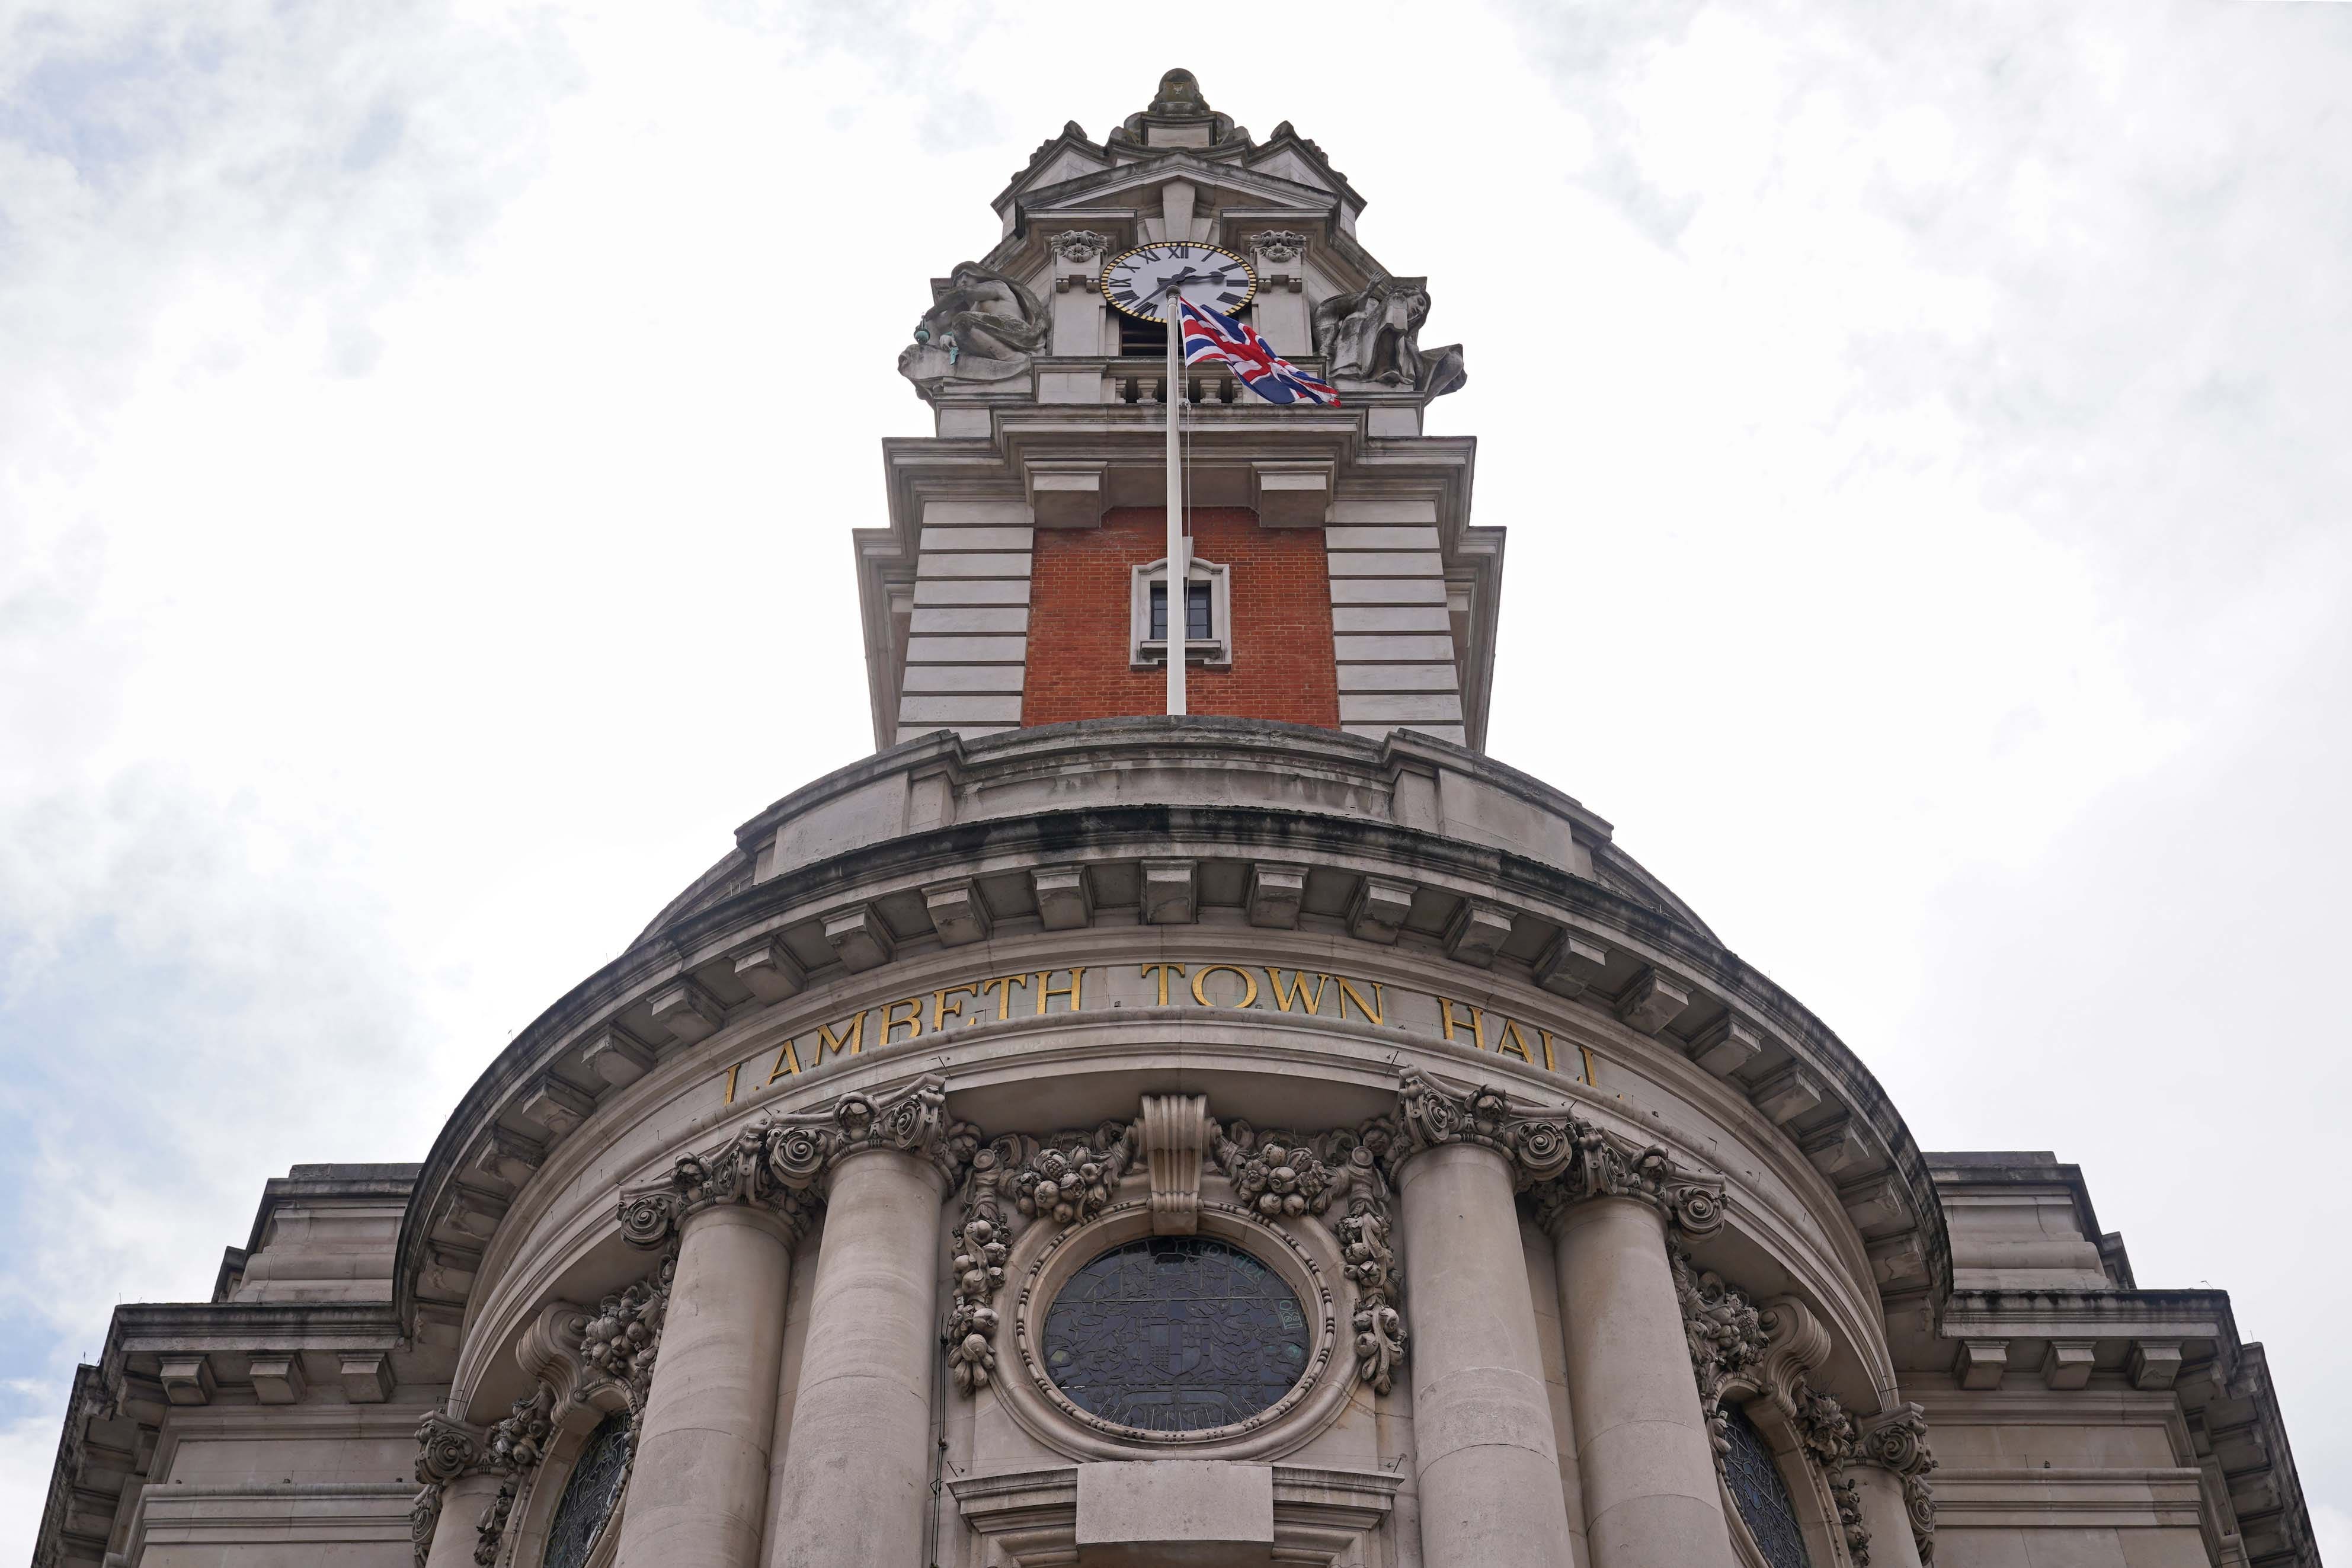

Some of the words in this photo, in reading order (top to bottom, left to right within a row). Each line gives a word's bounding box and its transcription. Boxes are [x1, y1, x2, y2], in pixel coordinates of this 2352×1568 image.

[1136, 249, 1161, 264] XI
[1166, 246, 1189, 259] XII
[1116, 262, 1141, 273] X
[1109, 278, 1132, 287] IX
[1141, 963, 1384, 1026] TOWN
